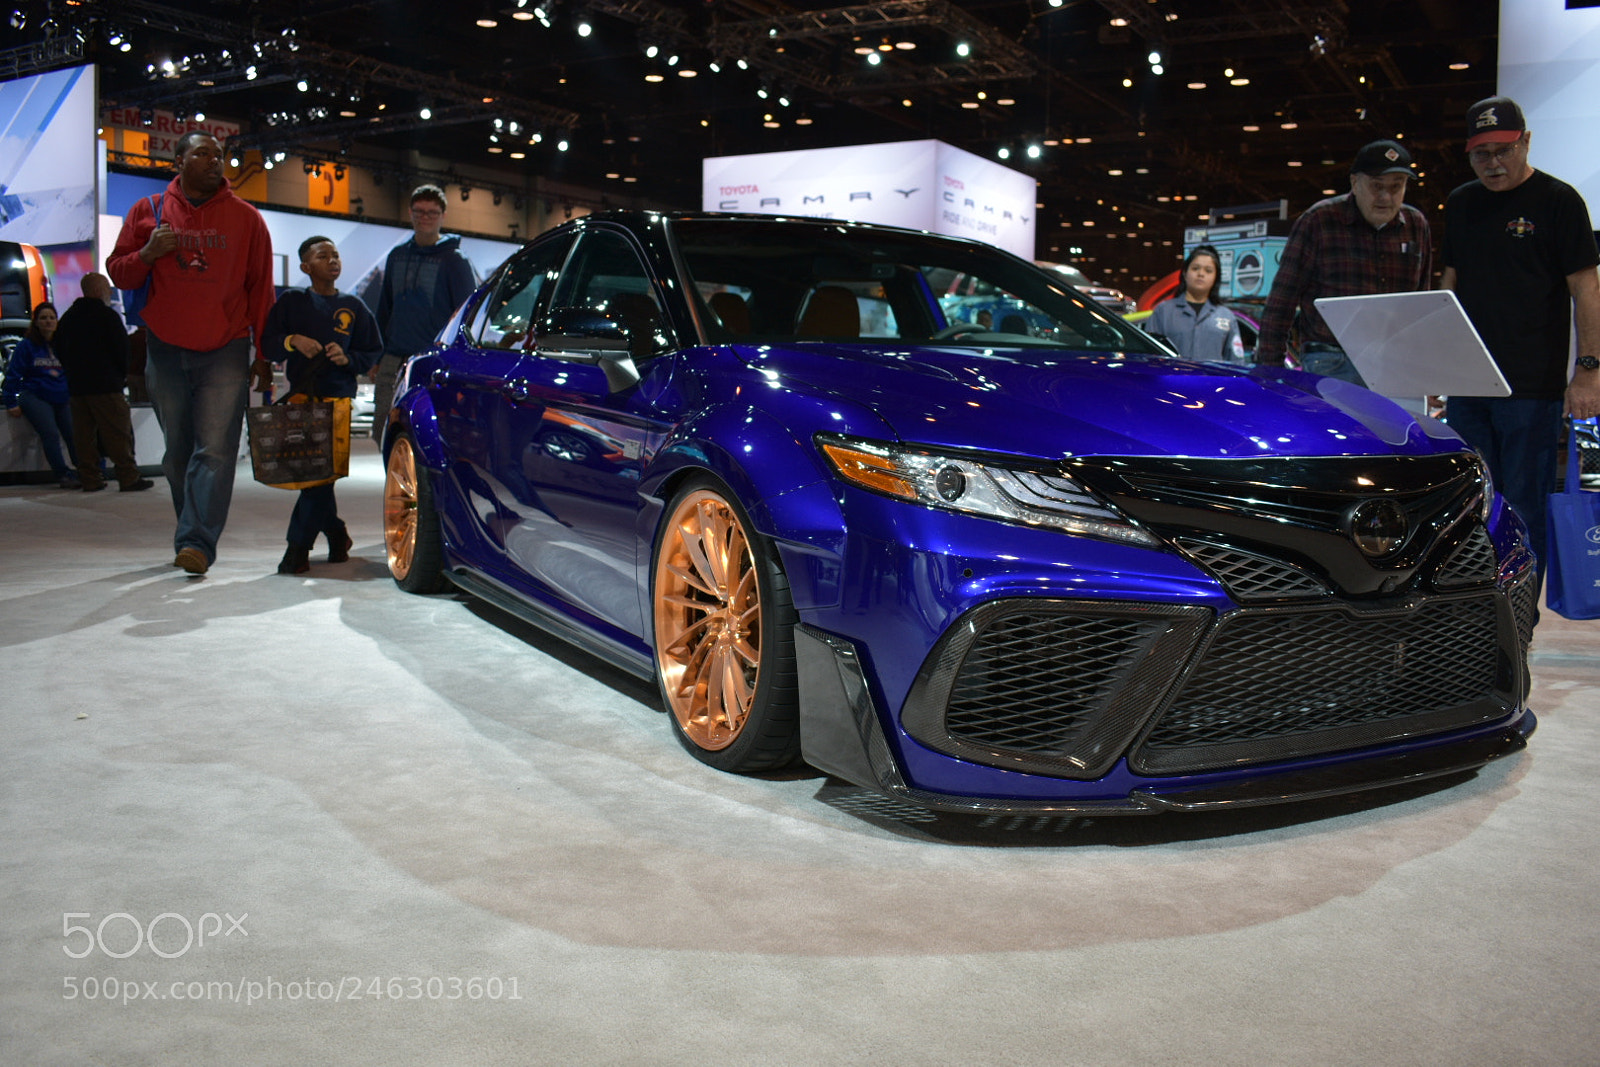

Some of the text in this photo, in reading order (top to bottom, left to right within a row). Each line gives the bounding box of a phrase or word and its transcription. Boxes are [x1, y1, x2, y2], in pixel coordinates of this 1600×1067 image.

[149, 137, 178, 152] EXI
[719, 184, 760, 196] TOYOTA
[719, 188, 921, 210] CAMRY
[943, 191, 1030, 225] CAMRY
